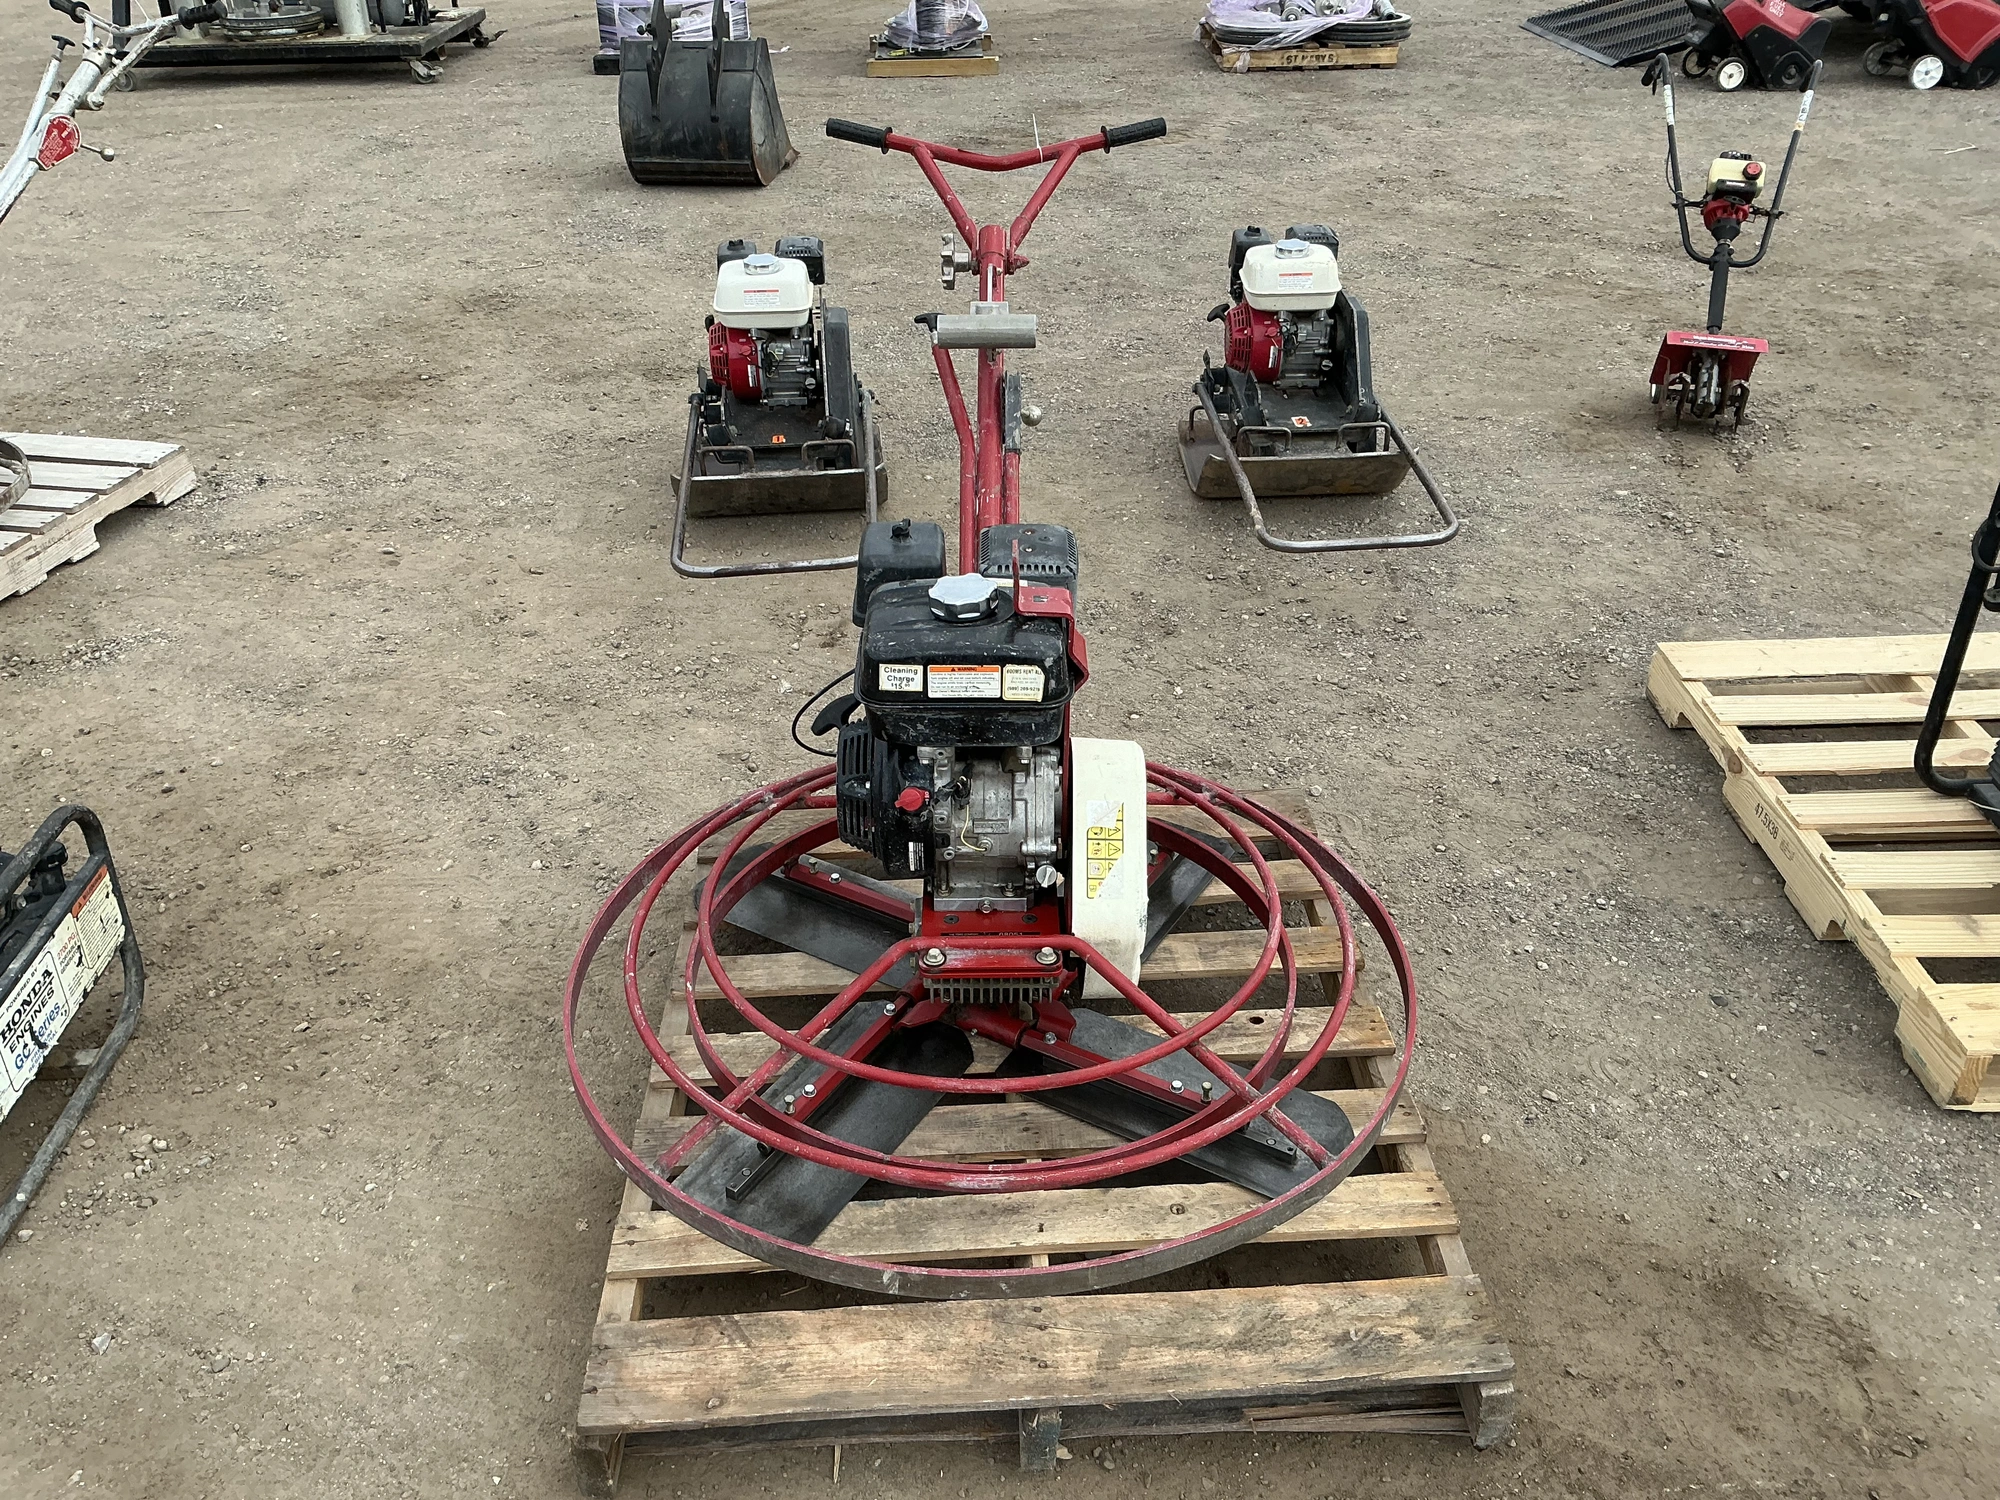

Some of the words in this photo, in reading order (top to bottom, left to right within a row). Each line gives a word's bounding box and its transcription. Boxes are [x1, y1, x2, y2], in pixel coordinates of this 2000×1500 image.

[1286, 55, 1298, 64] ST
[883, 666, 918, 675] Cleaning
[886, 675, 915, 683] Charge
[60, 944, 79, 975] GENERATO
[6, 977, 31, 1012] POWERED
[31, 967, 38, 978] BY
[0, 968, 53, 1044] HONDA
[9, 986, 55, 1054] ENGINES
